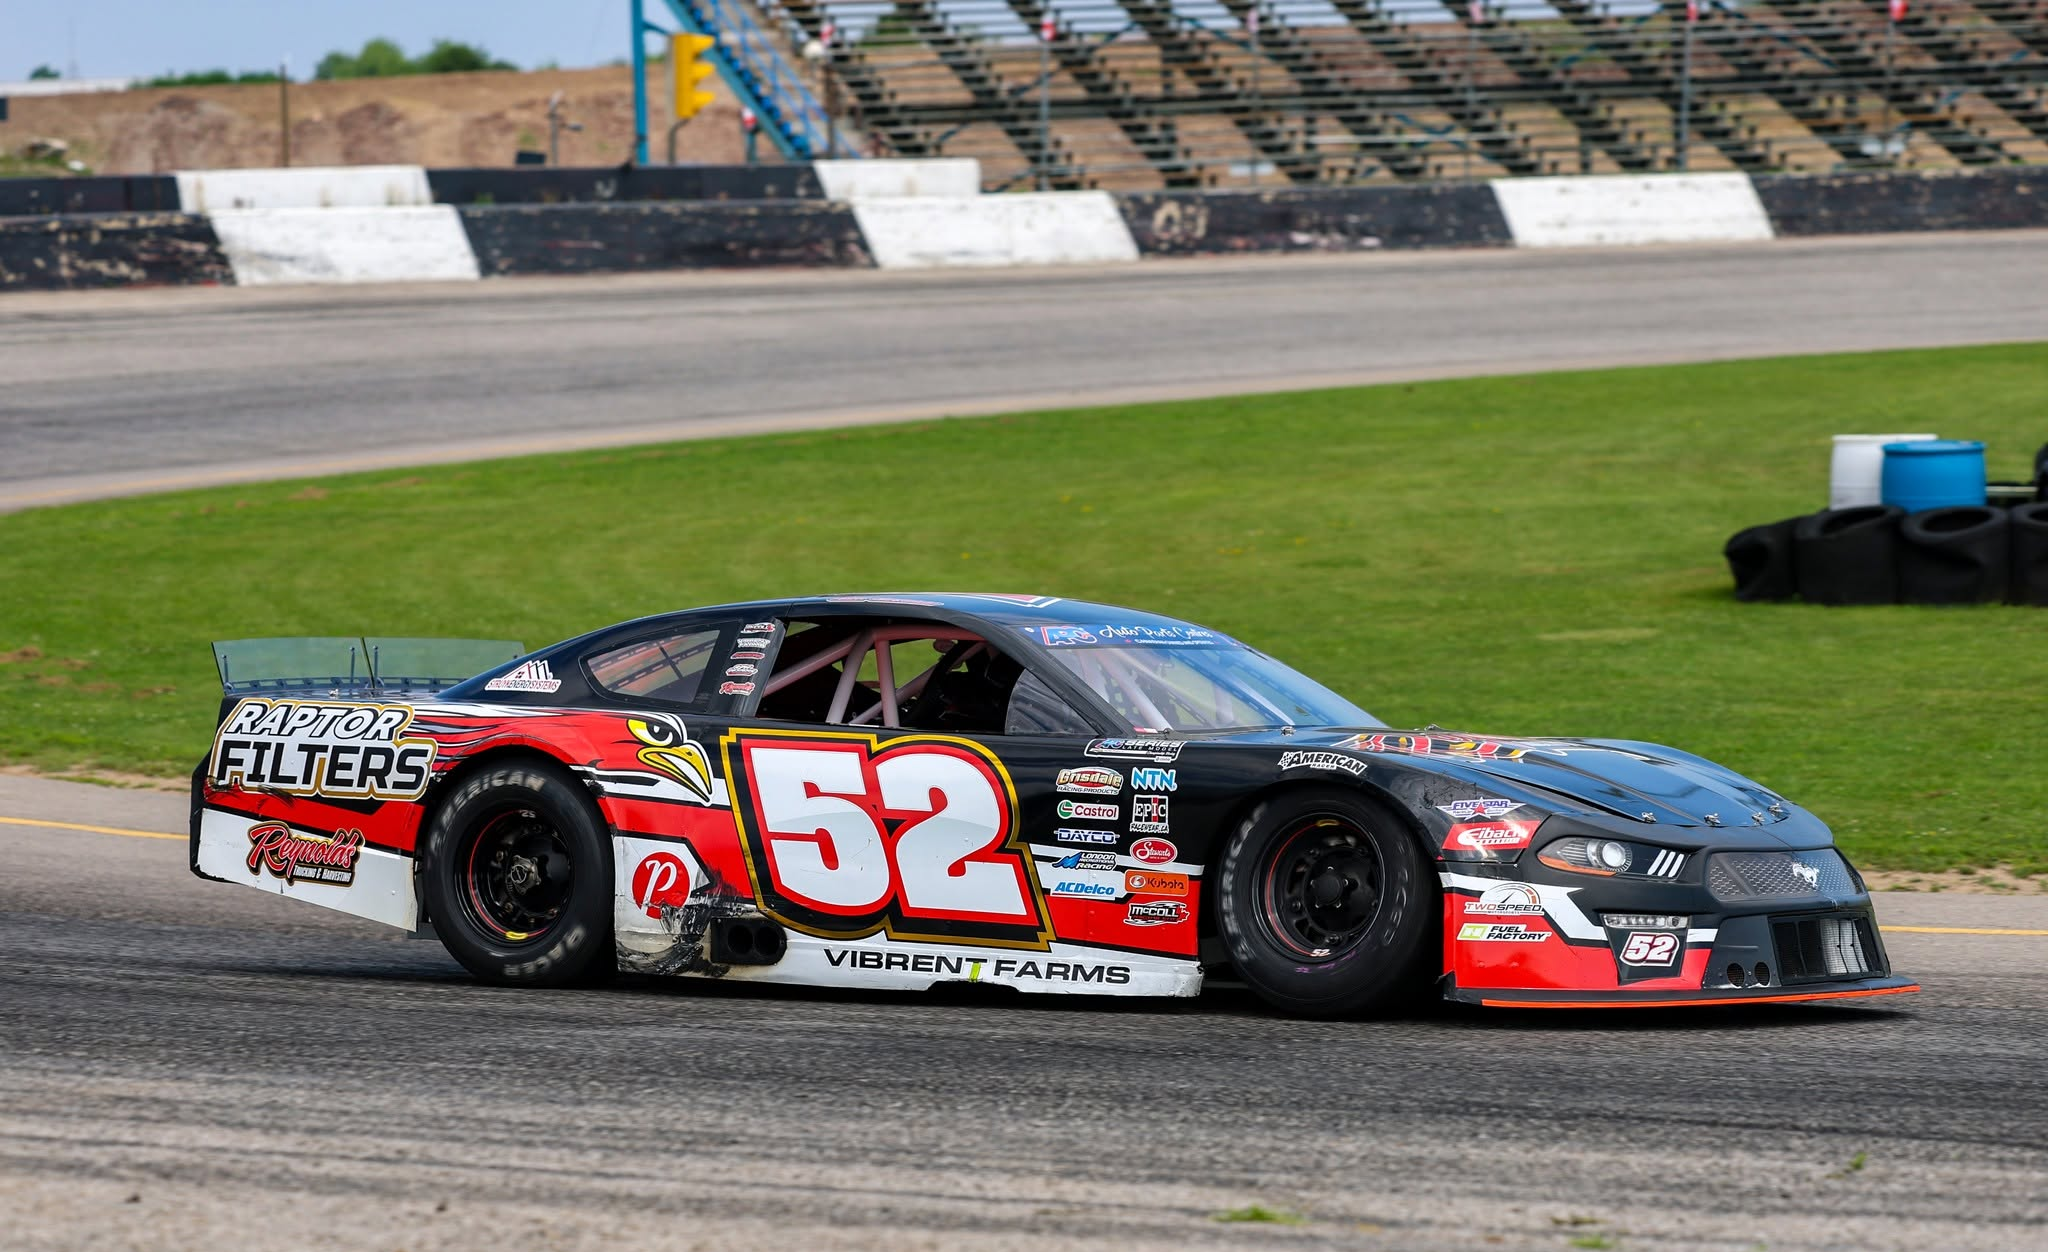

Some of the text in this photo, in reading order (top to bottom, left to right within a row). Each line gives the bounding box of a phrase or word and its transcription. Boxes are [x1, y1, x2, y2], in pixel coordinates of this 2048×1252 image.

[1099, 624, 1139, 638] Auto
[225, 703, 408, 740] RAPTOR
[1124, 739, 1181, 748] SERIES
[218, 740, 430, 790] FILTERS
[1285, 751, 1365, 774] AMERICAN
[1057, 770, 1122, 788] Grisdale
[1133, 768, 1175, 791] NTN
[1083, 787, 1118, 795] PRODUCTS
[1075, 805, 1117, 818] Castrol
[1134, 803, 1166, 817] EPIC
[1453, 800, 1508, 810] FIVE STAR
[744, 741, 1036, 922] 52
[1059, 829, 1115, 843] DAYCO
[249, 825, 358, 877] Reynolds
[1055, 882, 1115, 895] ACDelco
[1147, 877, 1184, 889] Kubota
[1310, 949, 1331, 957] 52
[1623, 933, 1678, 963] 52
[823, 948, 1131, 985] VIBRENT FARMS
